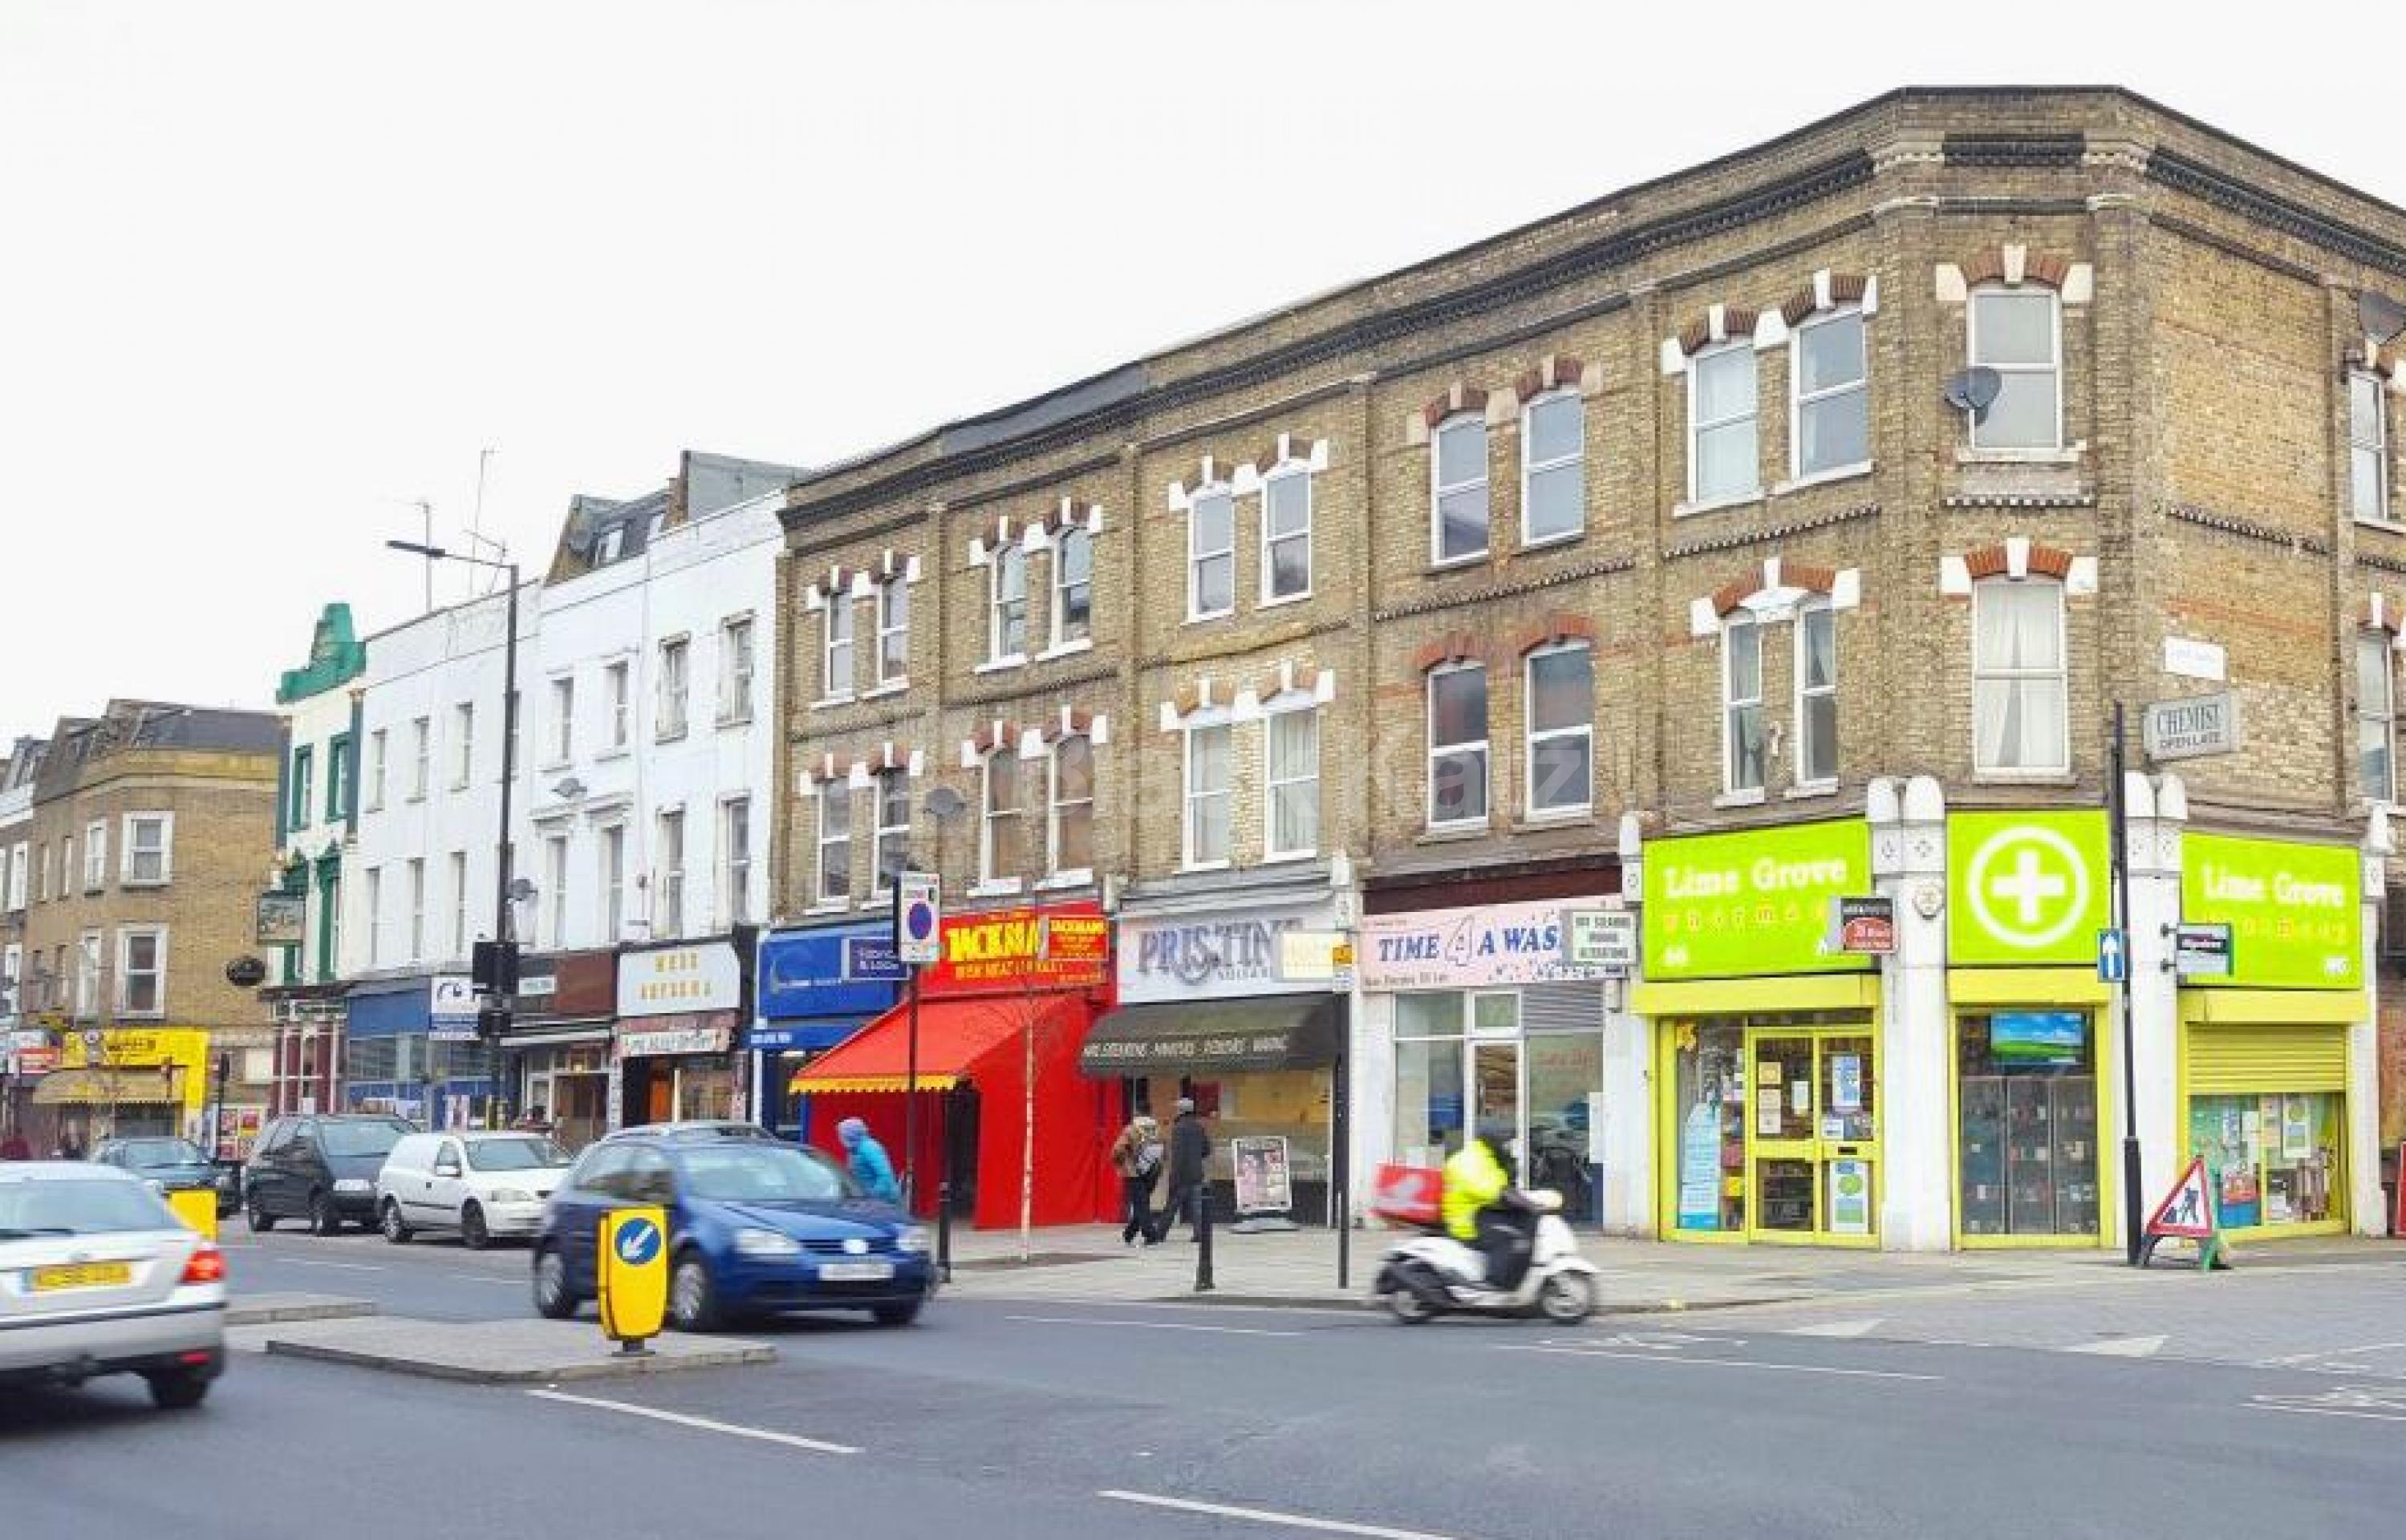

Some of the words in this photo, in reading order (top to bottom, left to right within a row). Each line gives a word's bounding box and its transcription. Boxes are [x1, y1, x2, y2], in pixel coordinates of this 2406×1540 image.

[2156, 703, 2220, 735] CHEMIST
[2159, 736, 2192, 749] OPEN
[1664, 866, 1739, 898] Lime
[1751, 857, 1847, 890] Grove
[2203, 864, 2264, 902] Lime
[2274, 873, 2343, 907] Grove
[1138, 918, 1303, 986] PRISTIN
[1378, 934, 1440, 962] TIME
[1445, 914, 1475, 967] 4
[1478, 930, 1495, 957] A
[1503, 925, 1560, 952] WAS
